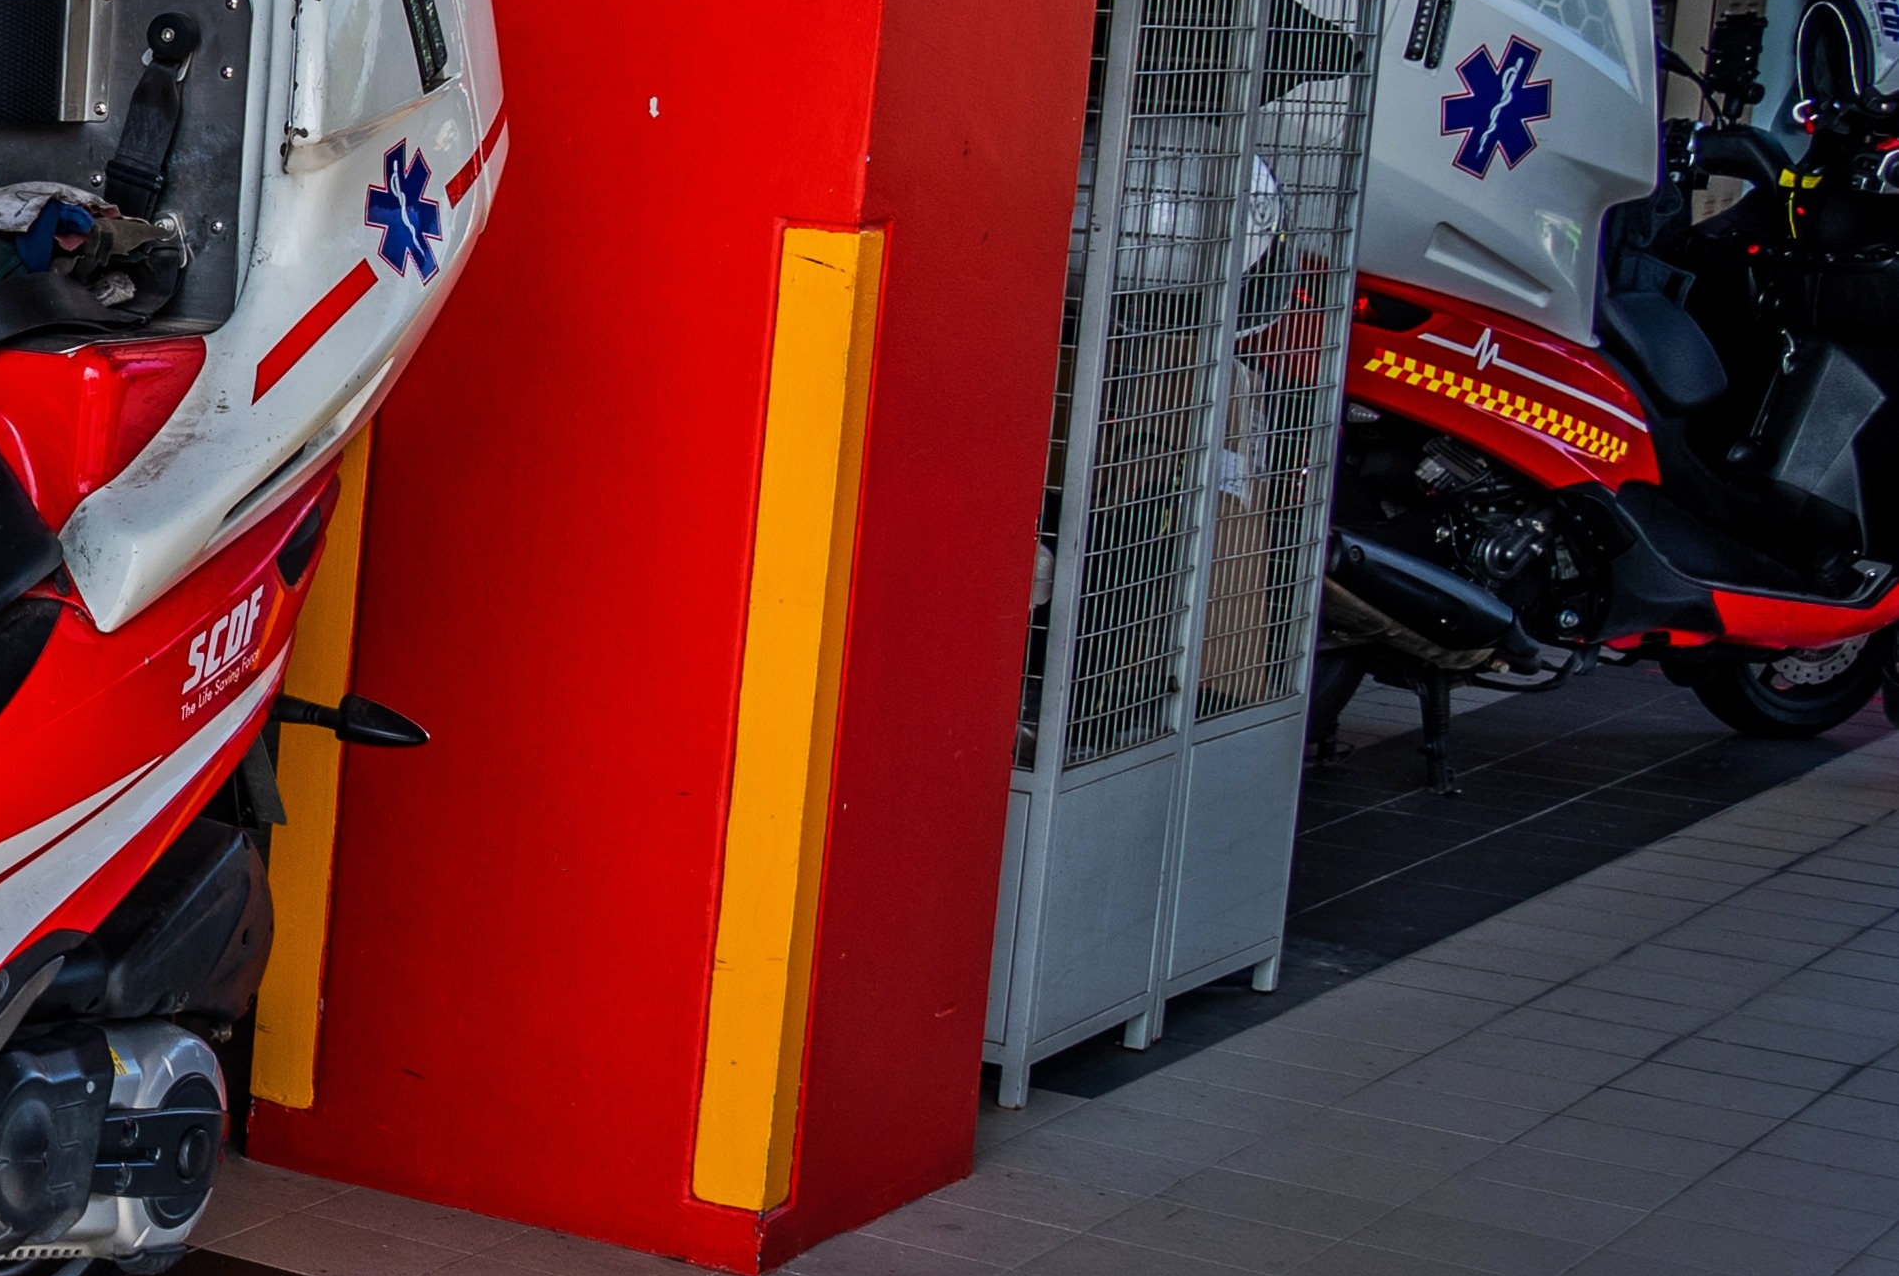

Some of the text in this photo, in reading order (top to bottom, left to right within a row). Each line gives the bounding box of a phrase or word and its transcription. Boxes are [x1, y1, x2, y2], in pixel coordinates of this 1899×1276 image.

[180, 648, 260, 721] The Life Saving Force
[181, 584, 264, 695] SCDF
